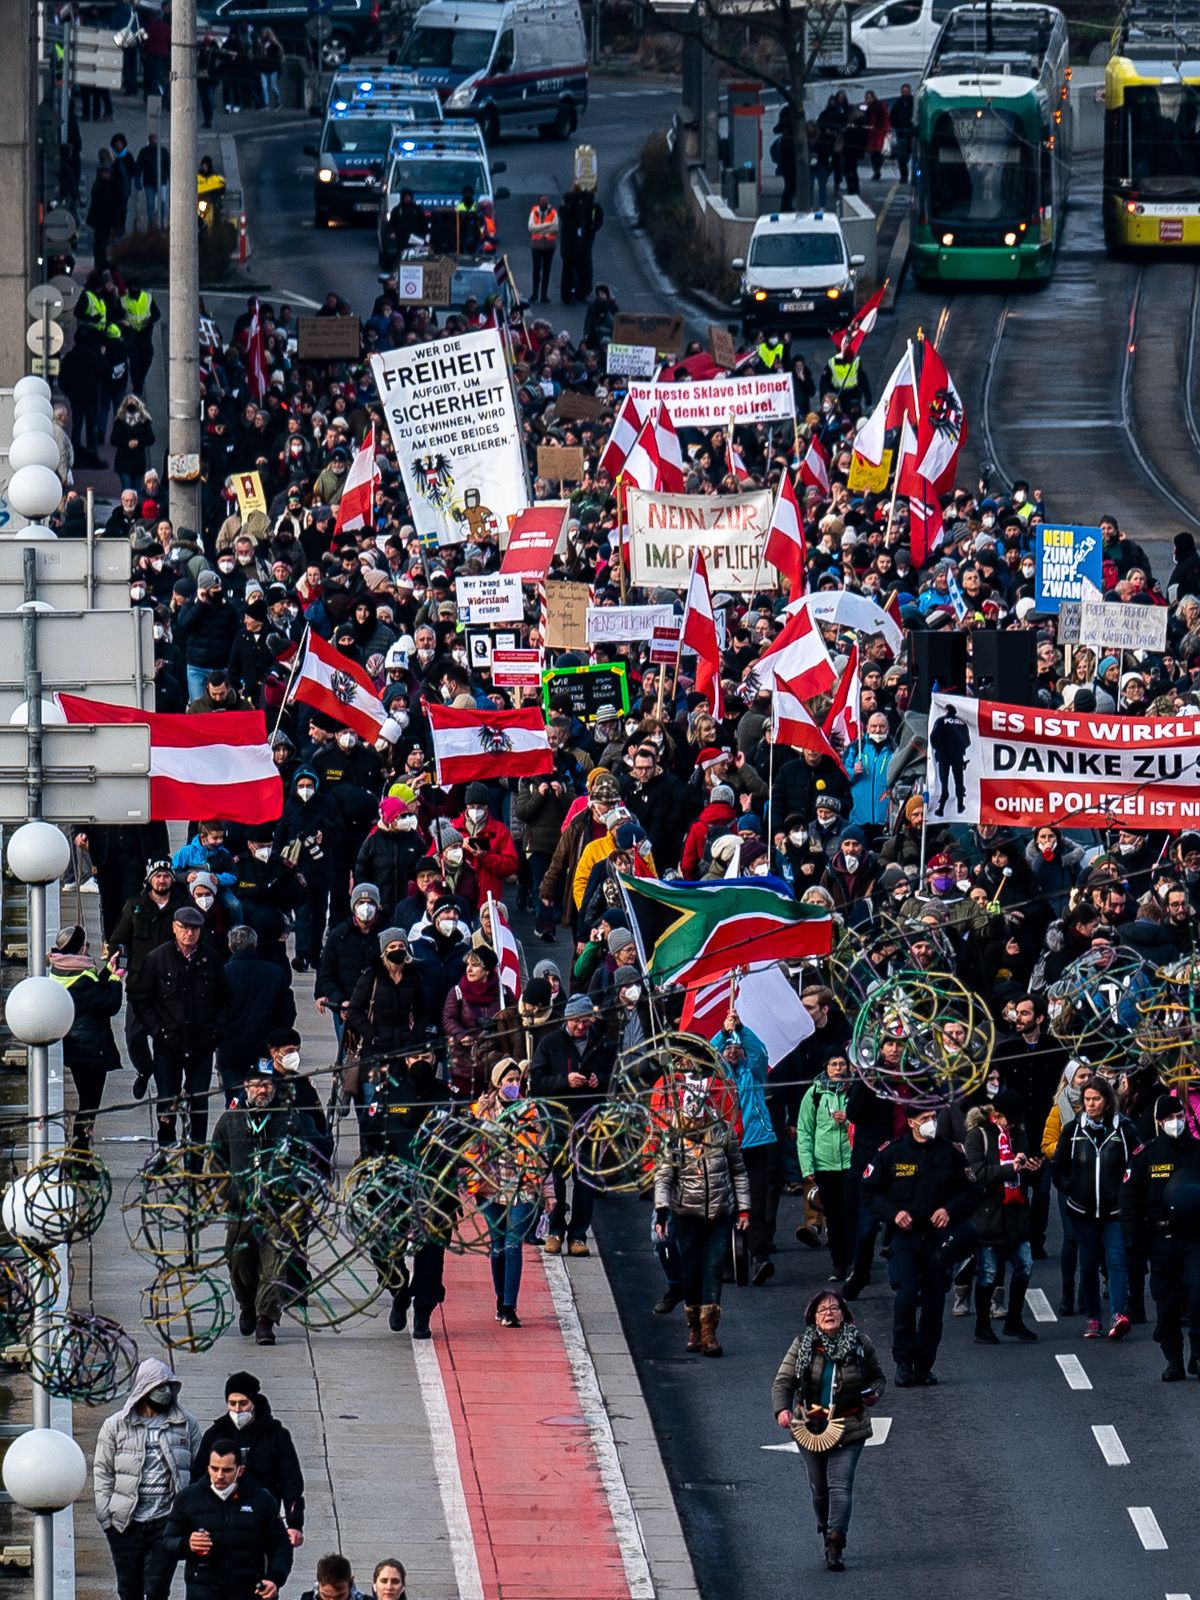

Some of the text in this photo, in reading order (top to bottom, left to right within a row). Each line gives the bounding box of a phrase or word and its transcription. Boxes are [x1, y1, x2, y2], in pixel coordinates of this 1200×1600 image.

[443, 341, 462, 353] DIE
[383, 348, 496, 392] FREIHEIT
[412, 377, 481, 400] AUFGIBT, UM
[631, 386, 651, 401] Der
[693, 383, 733, 398] Sklave
[755, 380, 790, 397] jener,
[392, 386, 504, 425] SICHERHEIT
[650, 406, 673, 419] dr
[674, 402, 710, 419] denkt
[713, 405, 726, 416] er
[399, 407, 506, 439] ZU GEWINNEN, WIRD
[411, 423, 500, 451] AM ENDE BEIDES
[648, 502, 758, 531] NEIN ZUR
[1043, 529, 1074, 547] NEIN
[1042, 547, 1074, 564] ZUM
[1042, 564, 1083, 581] IMPF-
[1042, 580, 1082, 599] ZWAN
[992, 710, 1025, 733] ES
[1034, 716, 1080, 738] IST
[993, 743, 1122, 777] DANKE
[1133, 755, 1182, 780] ZU
[995, 797, 1044, 813] OHNE
[1048, 791, 1145, 815] POLIZEI
[1150, 801, 1176, 817] IST
